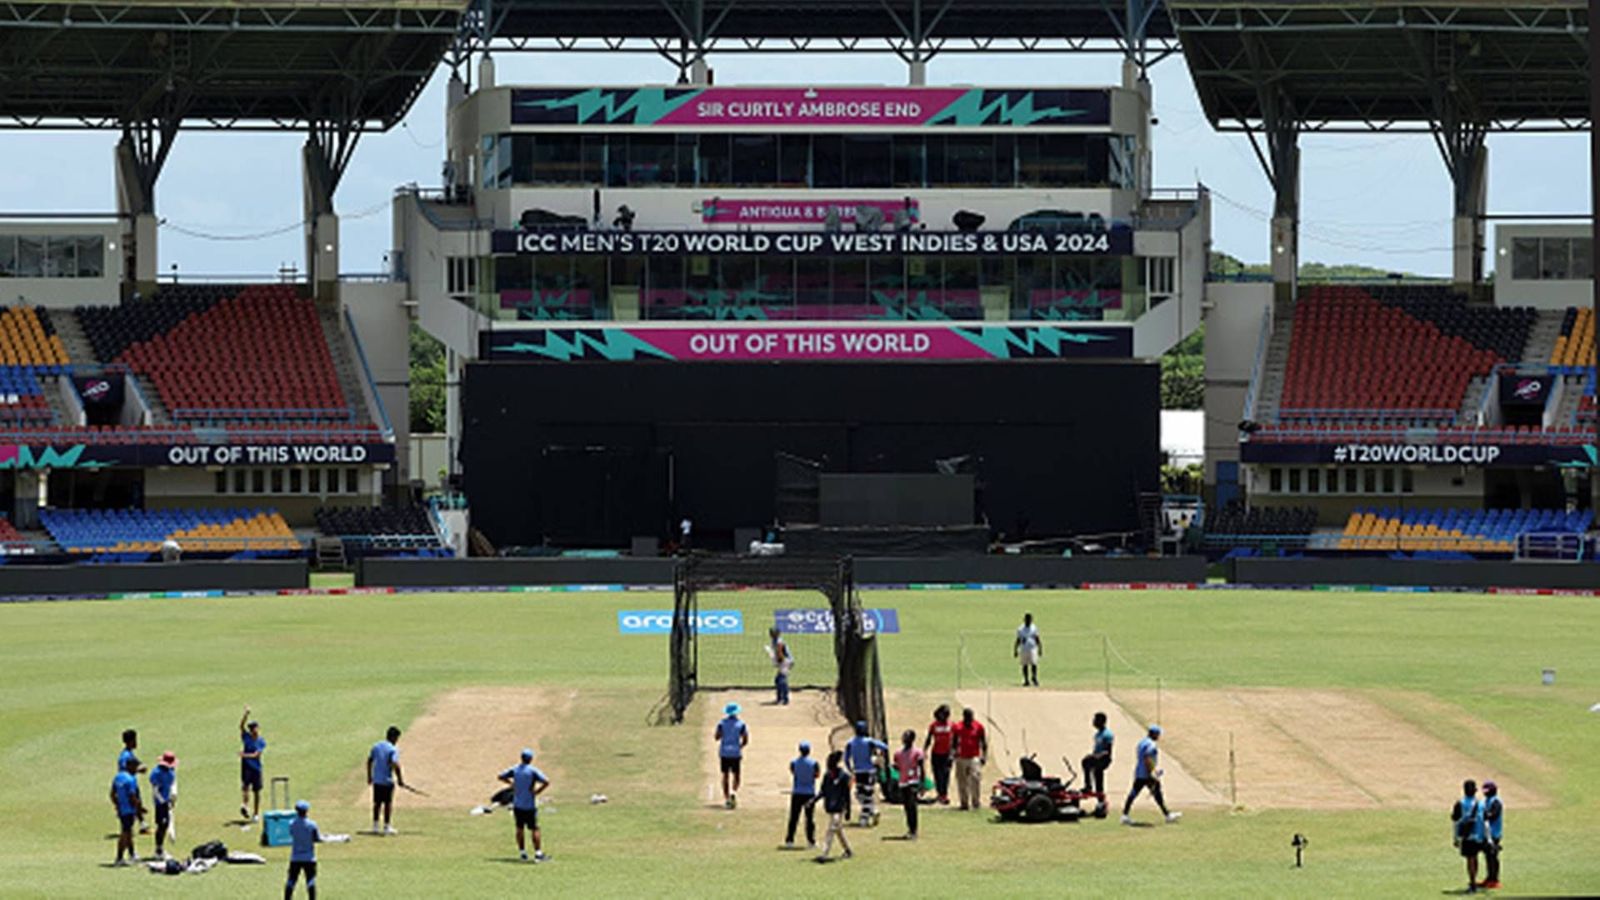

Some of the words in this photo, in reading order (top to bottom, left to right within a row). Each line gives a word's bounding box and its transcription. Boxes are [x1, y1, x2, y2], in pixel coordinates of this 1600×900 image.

[698, 102, 723, 117] SIR
[728, 102, 793, 117] CURTLY
[798, 102, 880, 117] AMBROSE
[885, 103, 921, 117] END
[738, 206, 801, 218] ANTIGUA
[517, 235, 556, 252] ICC
[561, 235, 633, 252] MEN'S
[641, 235, 679, 252] T20
[684, 235, 770, 252] WORLD
[776, 235, 823, 252] CUP
[831, 235, 895, 252] WEST
[902, 235, 978, 252] INDIES
[982, 235, 998, 252] &
[1003, 235, 1048, 252] USA
[1055, 235, 1109, 252] 2024
[690, 334, 738, 353] OUT
[745, 334, 778, 353] OF
[784, 334, 836, 352] THIS
[841, 333, 930, 352] WORLD
[169, 446, 210, 464] OUT
[214, 446, 242, 463] OF
[246, 446, 289, 463] THIS
[294, 446, 366, 462] WORLD
[1334, 445, 1500, 463] #T20WORLDCUP
